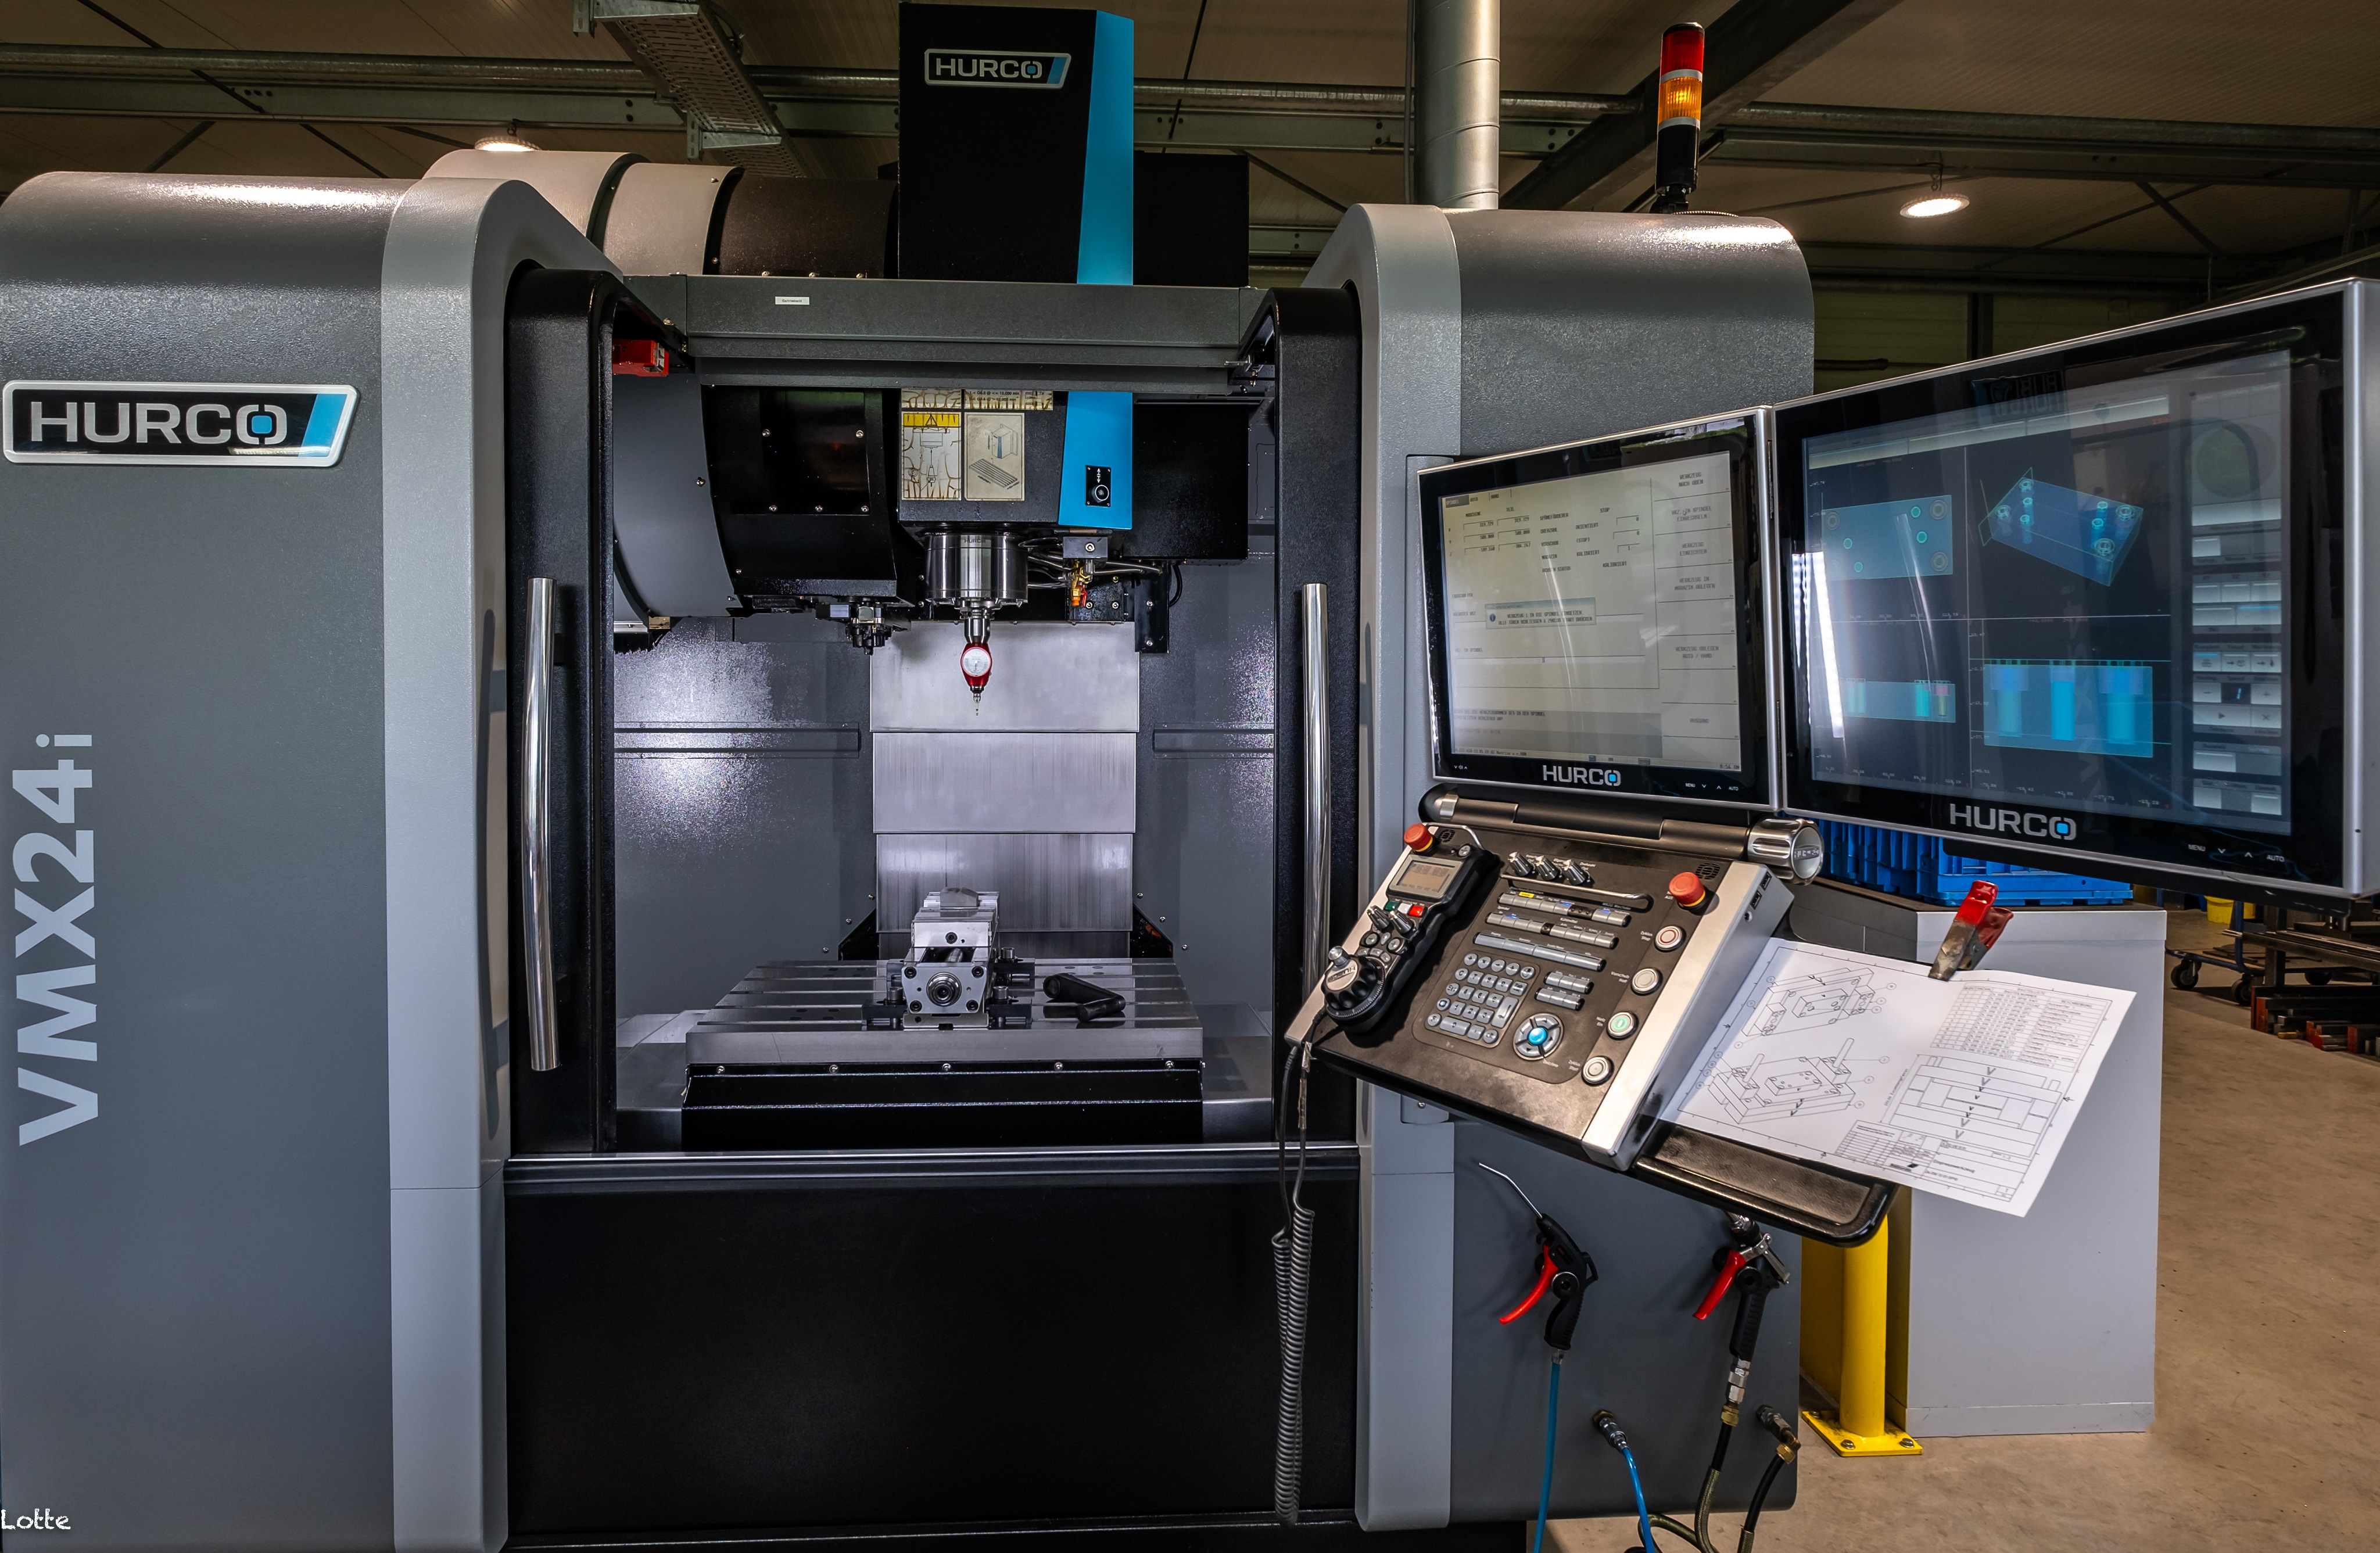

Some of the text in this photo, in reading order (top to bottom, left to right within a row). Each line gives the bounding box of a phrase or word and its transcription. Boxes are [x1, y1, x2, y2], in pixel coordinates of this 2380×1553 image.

[935, 58, 1042, 79] HURCO
[30, 401, 288, 445] HURCO
[1542, 764, 1621, 787] HURCO
[1949, 803, 2077, 841] HURCO
[2188, 844, 2285, 862] MENU AUTO
[12, 733, 98, 1146] VMX24i
